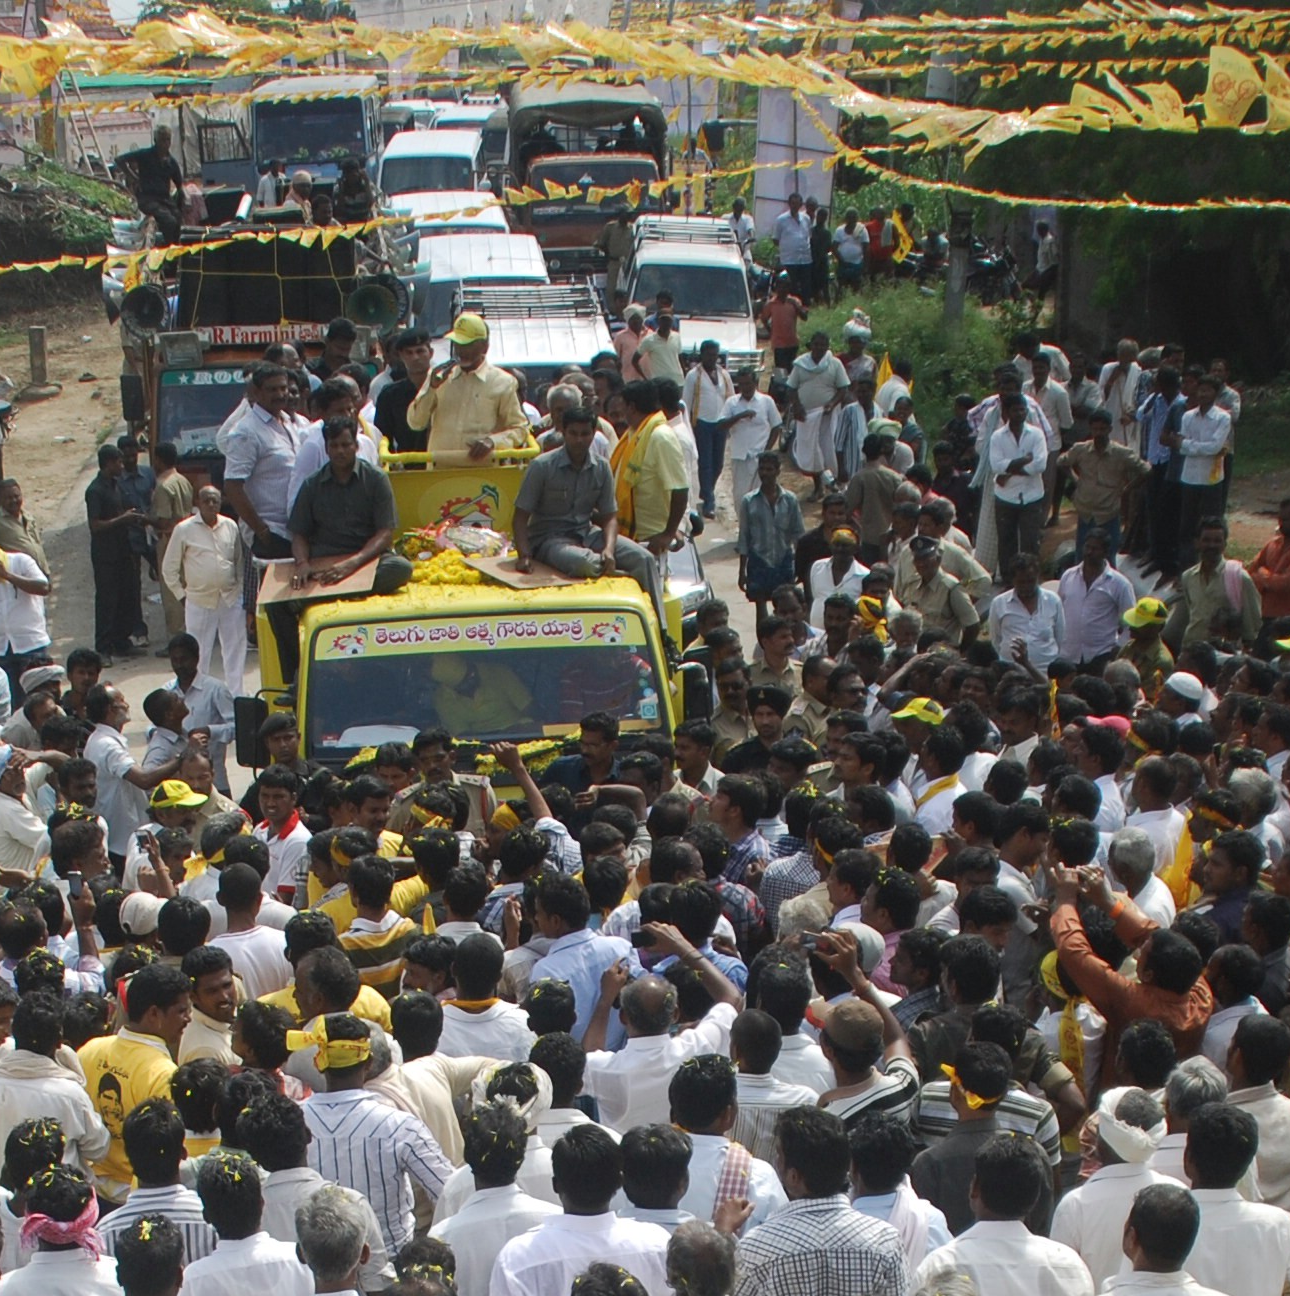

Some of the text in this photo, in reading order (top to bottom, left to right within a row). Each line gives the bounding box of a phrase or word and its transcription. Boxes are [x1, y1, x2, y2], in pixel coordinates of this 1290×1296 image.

[375, 619, 583, 647] తెలుగు జాతి ఆత్మ గౌరవ యాత్ర
